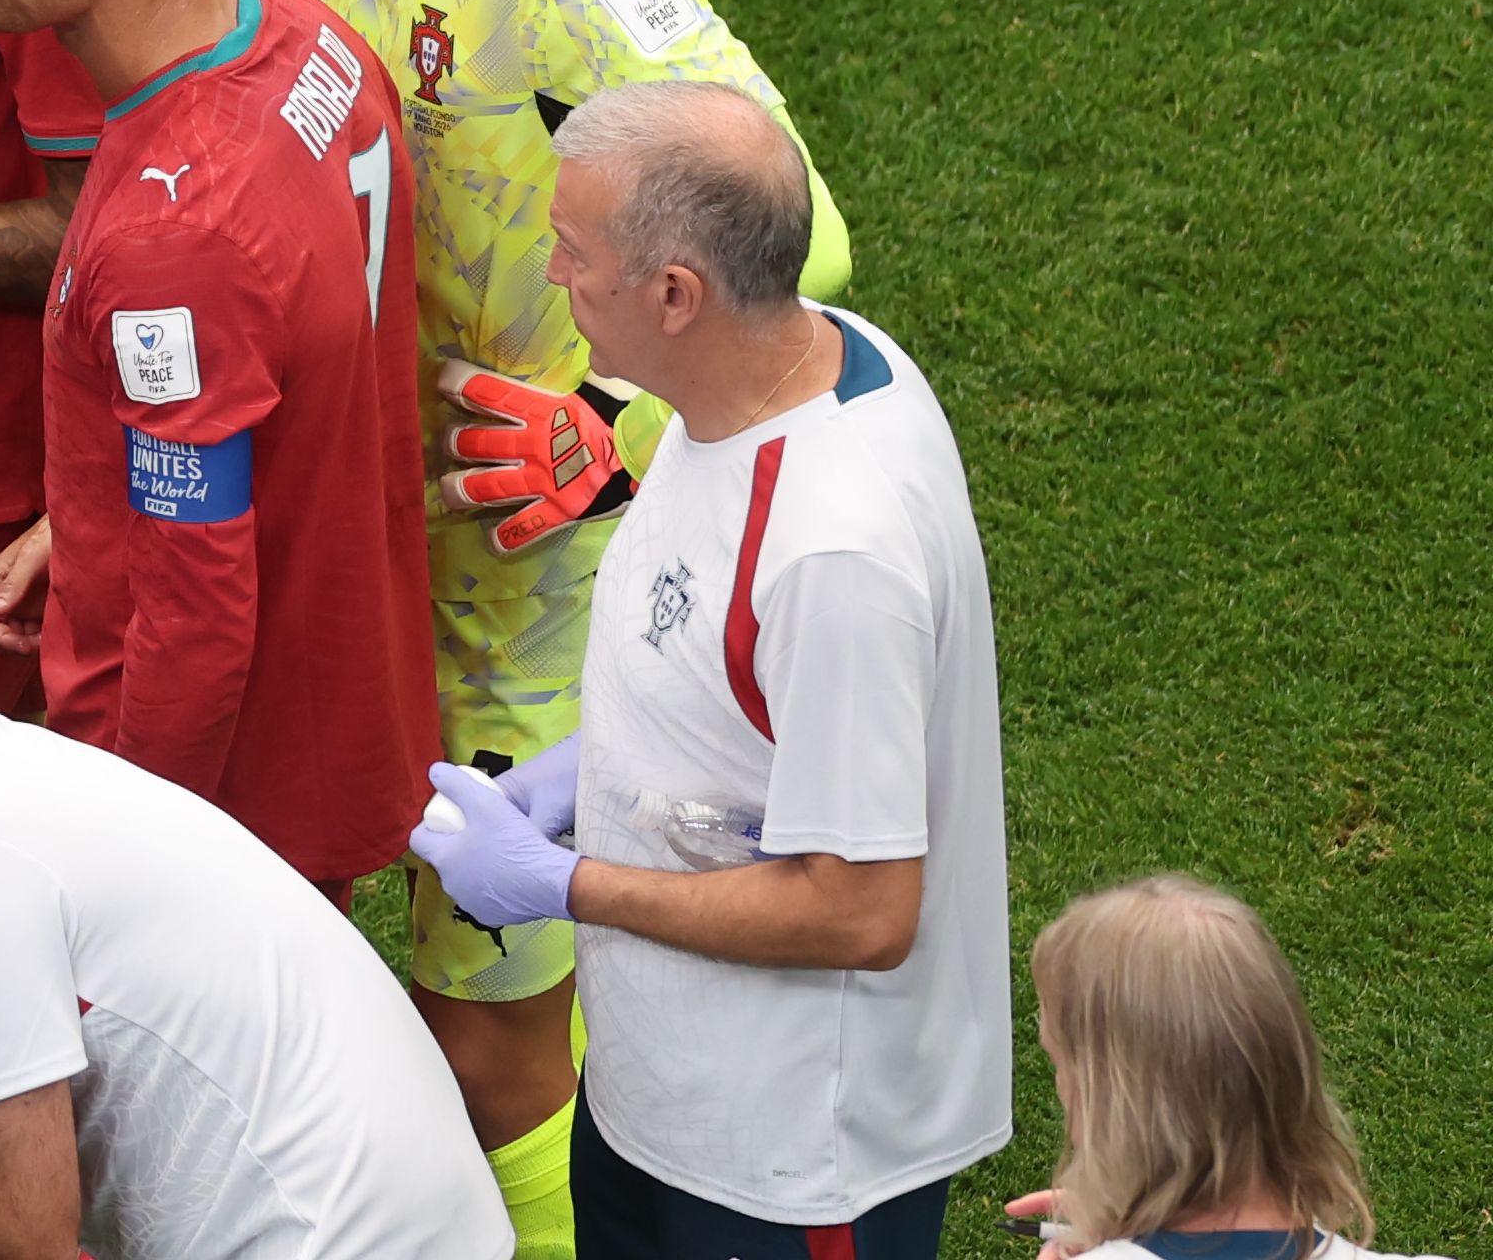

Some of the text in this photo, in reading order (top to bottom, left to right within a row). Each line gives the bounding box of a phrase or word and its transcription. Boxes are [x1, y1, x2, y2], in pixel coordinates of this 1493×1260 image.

[646, 0, 679, 30] PEACE
[279, 23, 363, 161] RONALDO
[348, 121, 392, 332] 7
[139, 367, 174, 383] PEACE
[148, 385, 166, 393] FIFA
[132, 445, 203, 480] UNITES
[130, 469, 209, 502] the World
[146, 500, 174, 515] FIFA
